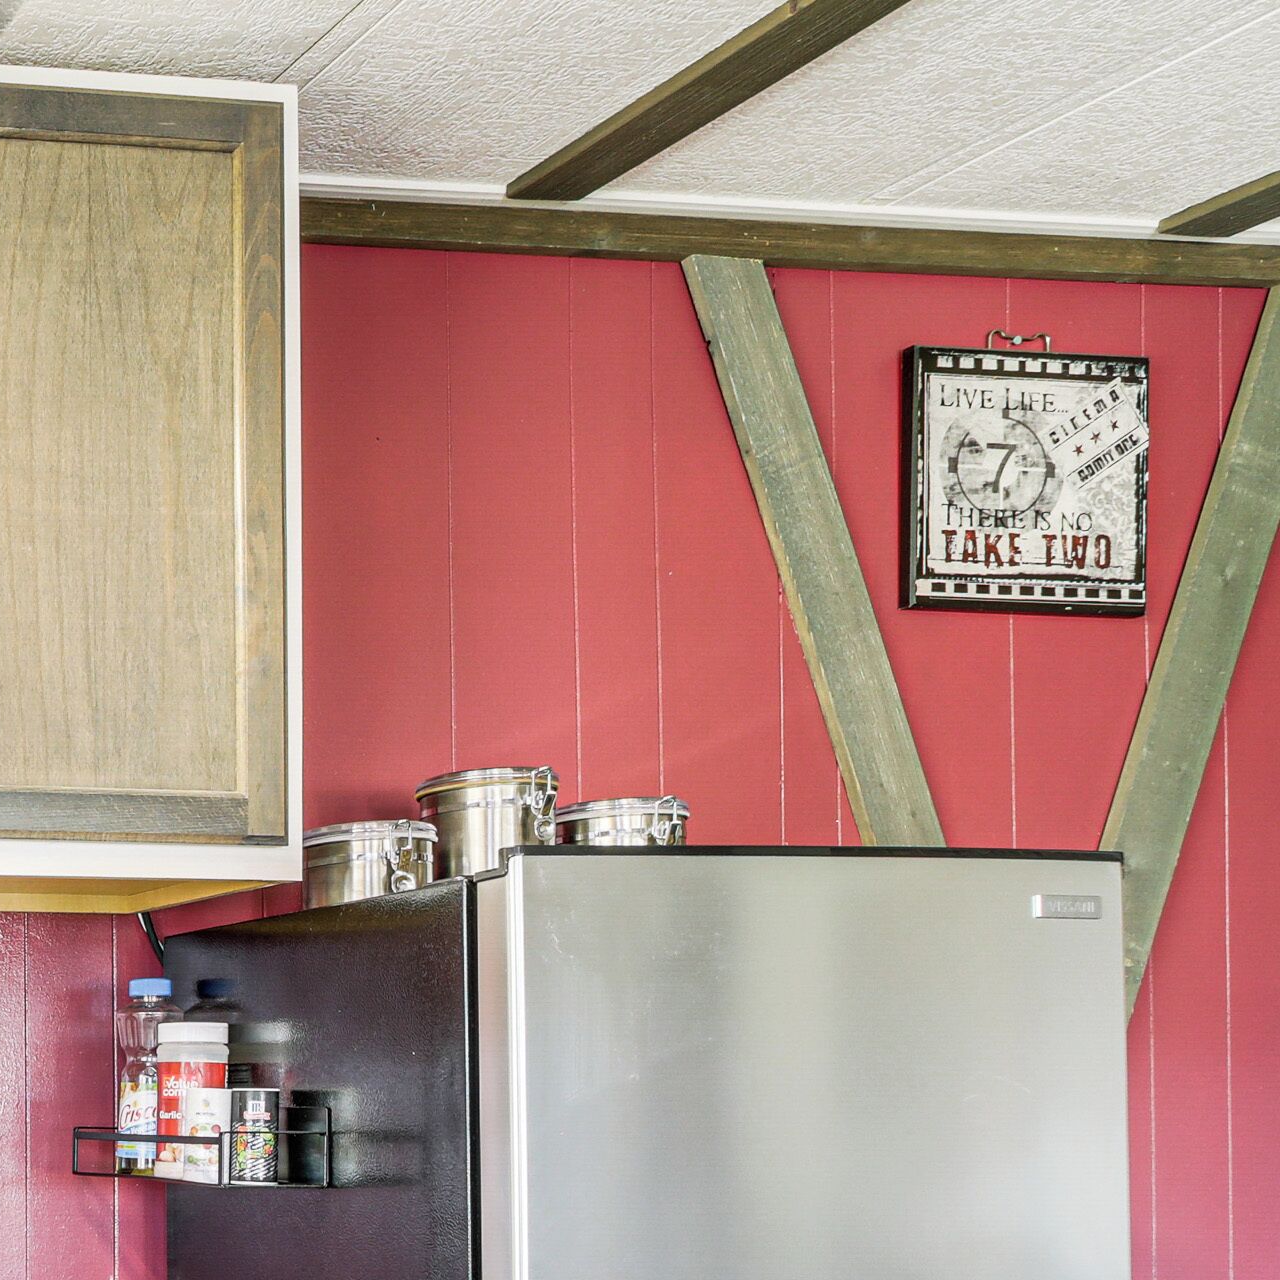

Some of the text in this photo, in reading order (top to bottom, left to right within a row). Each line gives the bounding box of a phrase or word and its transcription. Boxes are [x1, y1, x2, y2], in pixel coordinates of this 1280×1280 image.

[939, 383, 995, 409] LIVE
[986, 443, 1017, 494] 7
[941, 503, 1093, 532] THERE IS NO
[941, 529, 1112, 569] TAKE TWO
